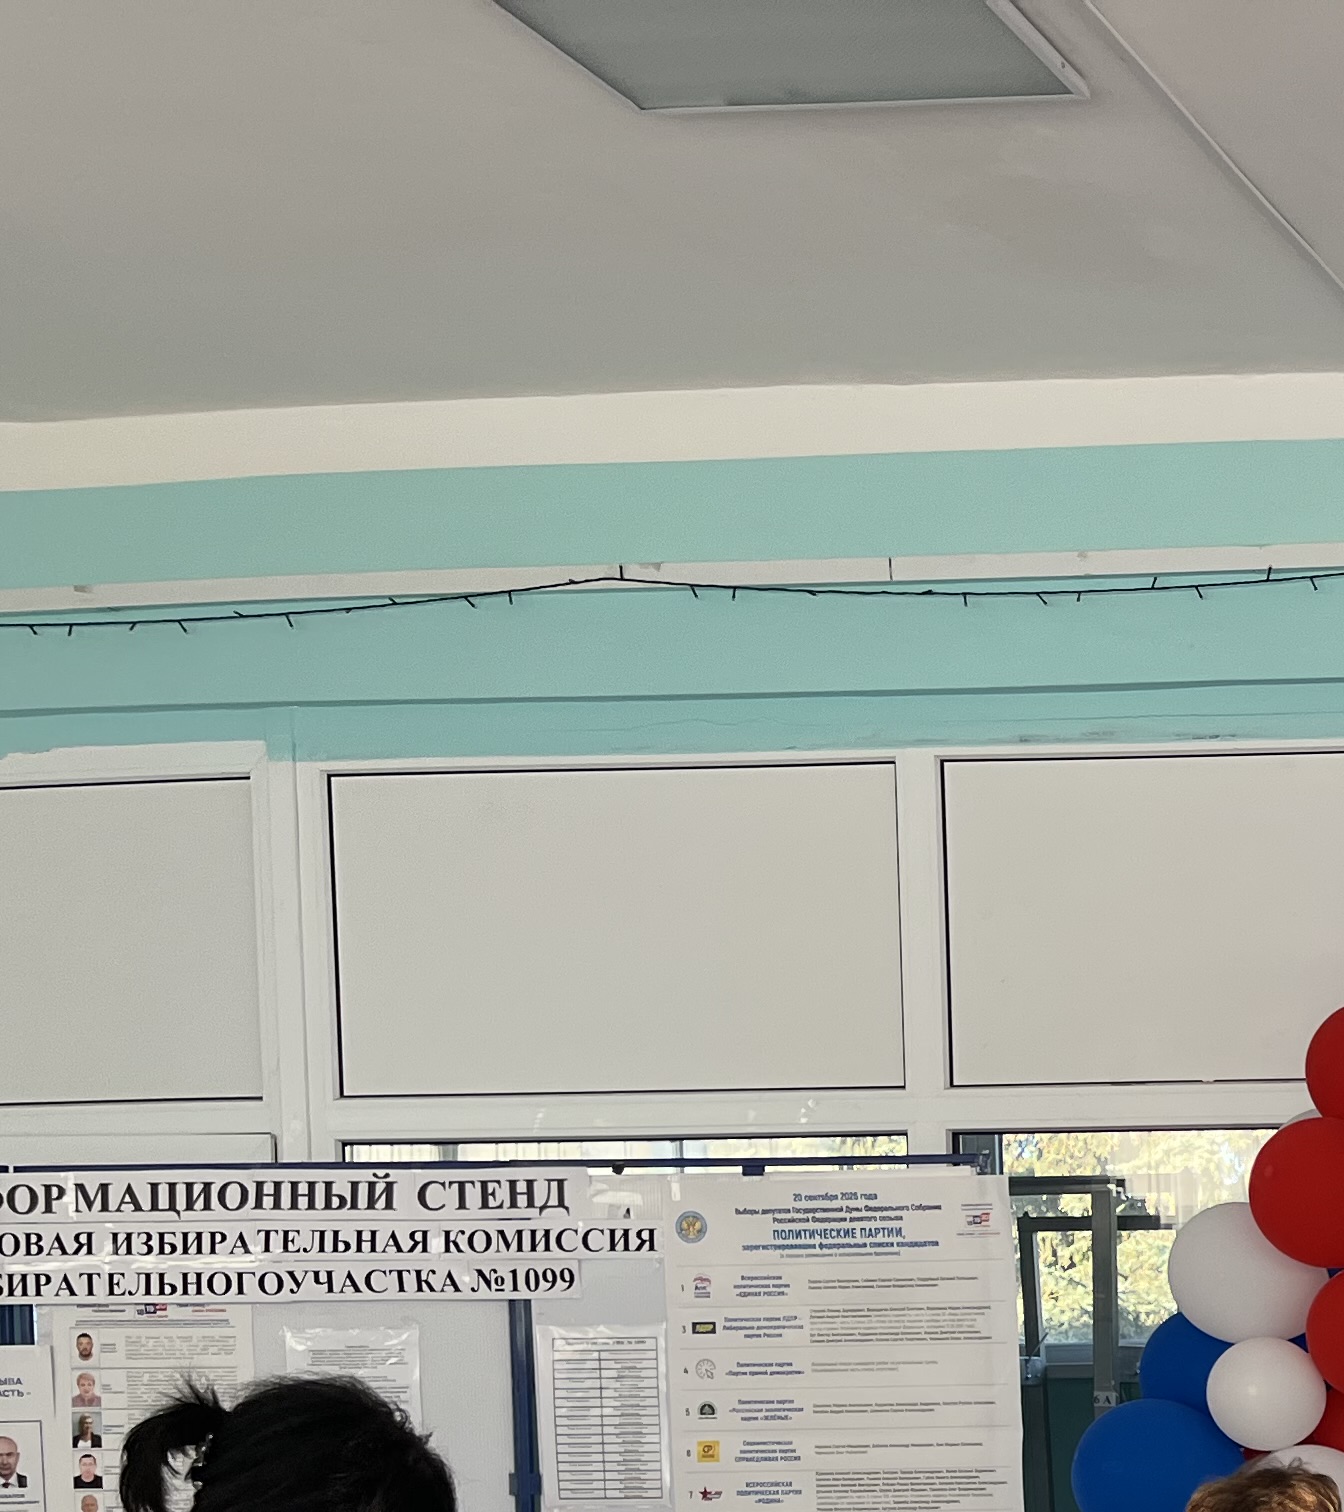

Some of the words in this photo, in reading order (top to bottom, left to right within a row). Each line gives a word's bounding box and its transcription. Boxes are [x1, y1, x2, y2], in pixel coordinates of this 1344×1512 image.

[0, 1172, 398, 1220] ОРМАЦИОННЫЙ
[417, 1178, 571, 1217] СТЕНД
[109, 1229, 431, 1256] ИЗБИРАТЕЛЬНАЯ
[441, 1227, 657, 1254] КОМИССИЯ
[772, 1227, 857, 1240] ПОЛИТИЧЕСКИЕ
[860, 1226, 906, 1239] ПАРТИИ,
[470, 1267, 575, 1293] №1099
